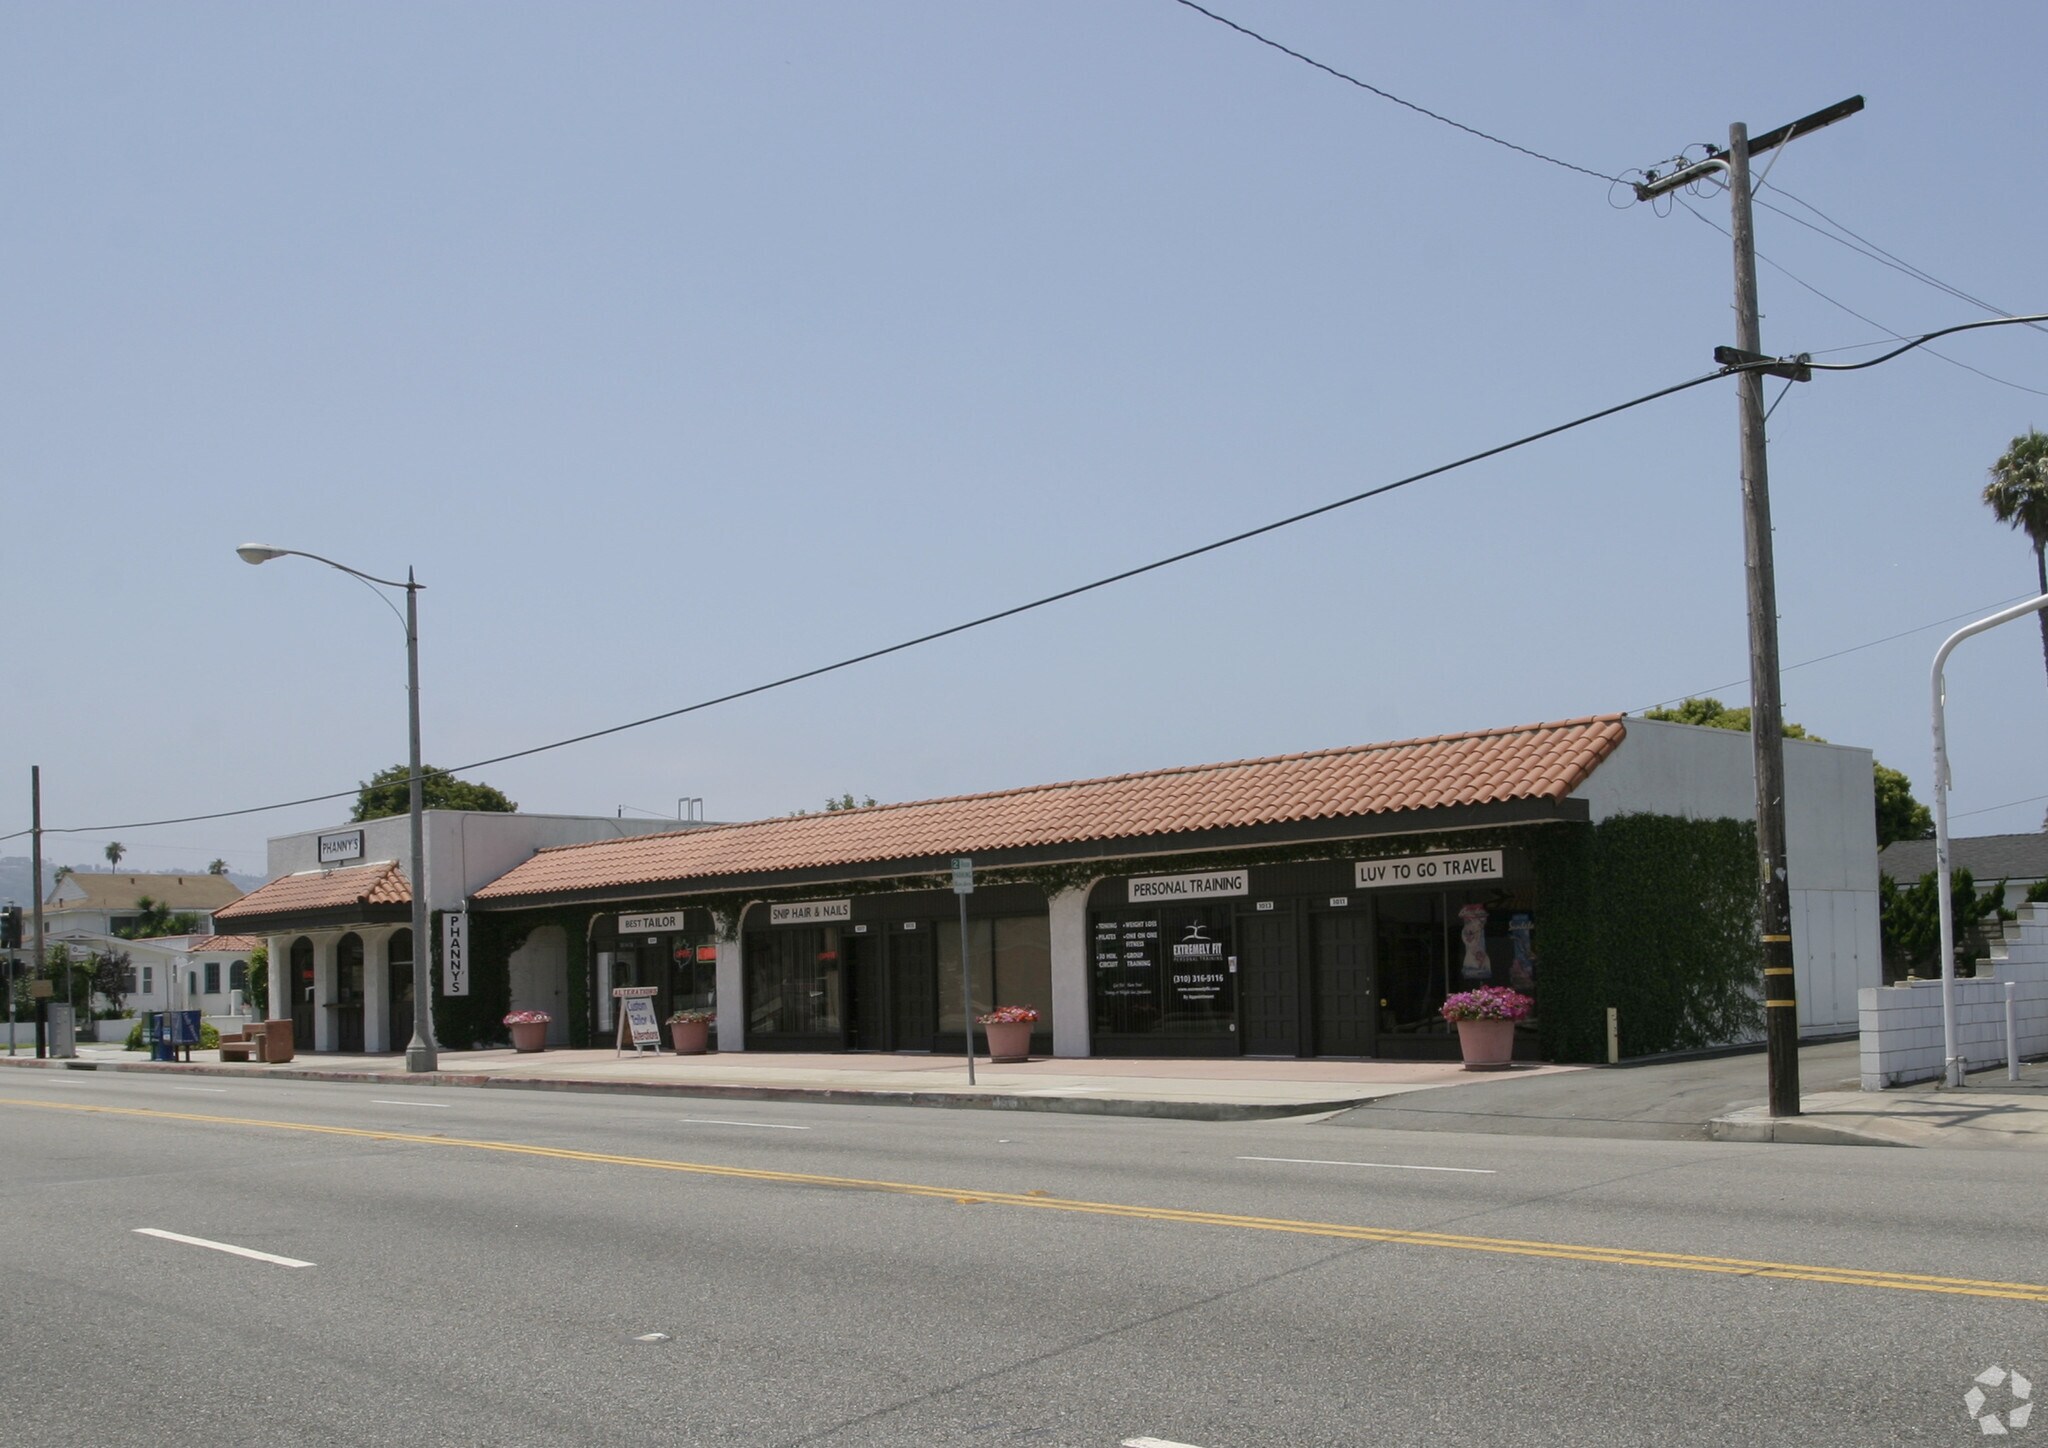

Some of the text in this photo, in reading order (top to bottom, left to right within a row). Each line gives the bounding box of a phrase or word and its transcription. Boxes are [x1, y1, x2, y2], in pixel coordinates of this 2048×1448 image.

[322, 838, 359, 854] PHANNY'S
[1361, 857, 1496, 882] LUV TO GO TRAVEL
[1134, 876, 1242, 896] PERSONAL TRAINING
[773, 905, 848, 919] SNIP HAIR & NAILS
[625, 916, 676, 928] BEST TAILOR
[450, 916, 464, 993] PHANNY'S
[1173, 943, 1222, 955] EXTREMELY FIT
[1173, 974, 1224, 983] (310) 316-9116
